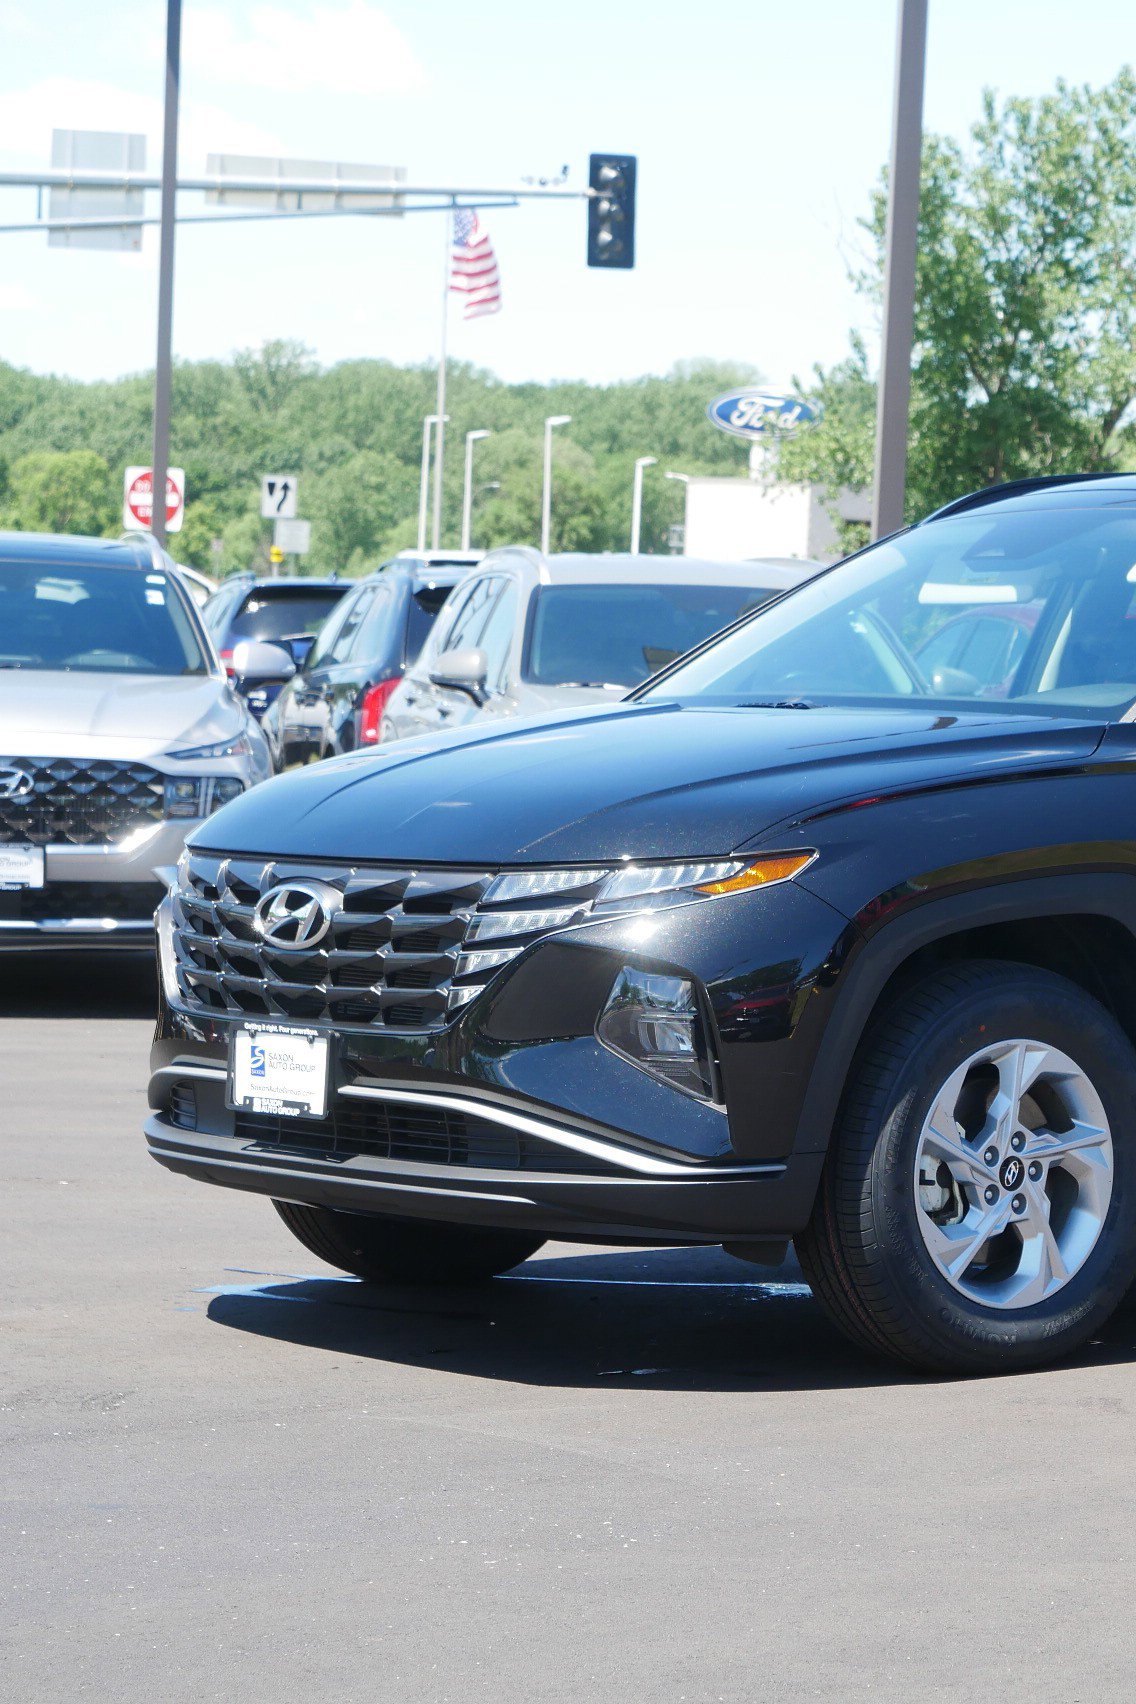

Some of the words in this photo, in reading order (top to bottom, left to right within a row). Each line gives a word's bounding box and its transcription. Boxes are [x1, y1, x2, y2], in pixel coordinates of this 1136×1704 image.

[729, 396, 802, 429] Ford
[268, 1052, 294, 1062] SAXON
[268, 1061, 288, 1070] AUTO
[289, 1063, 316, 1073] GROUP
[261, 1098, 284, 1107] SAXON
[261, 1105, 278, 1114] AUTO
[278, 1106, 301, 1117] GROUP
